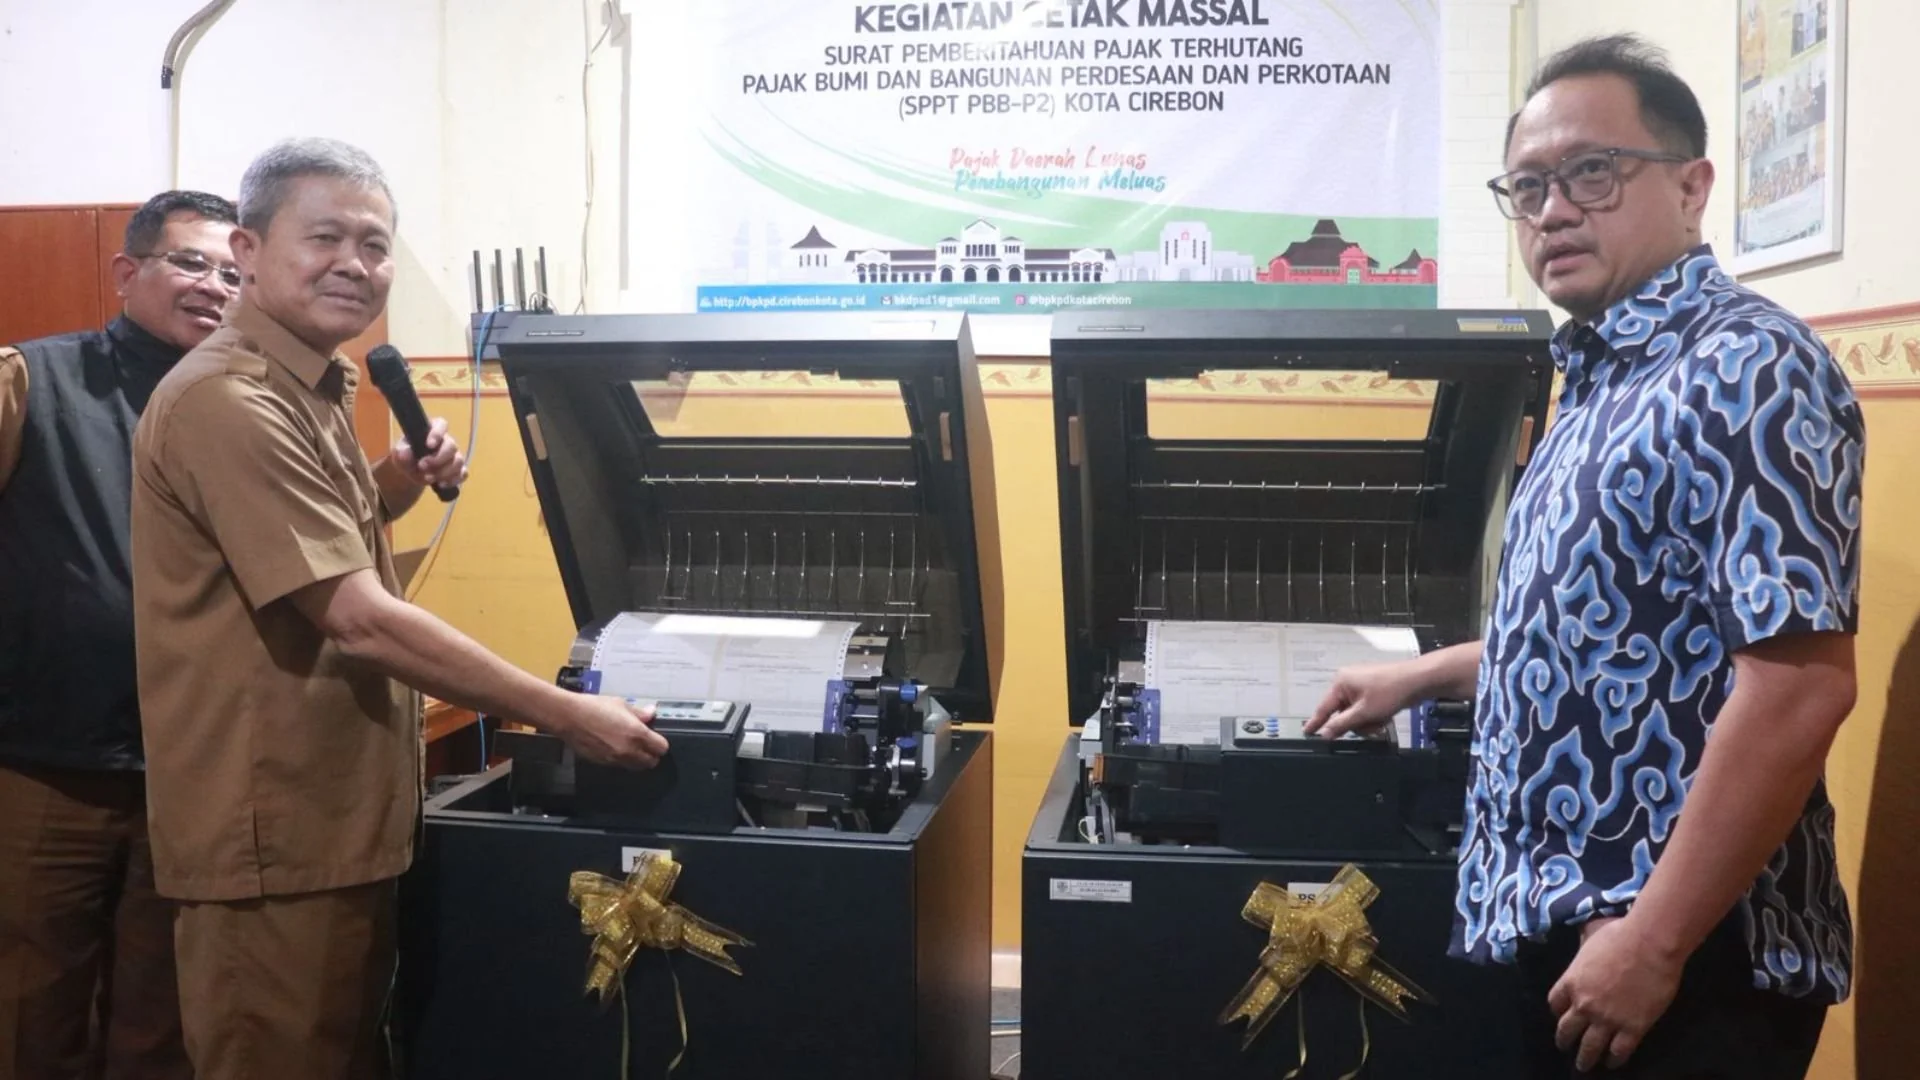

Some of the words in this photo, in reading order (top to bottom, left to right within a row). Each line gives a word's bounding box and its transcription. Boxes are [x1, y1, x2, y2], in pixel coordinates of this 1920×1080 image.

[855, 2, 1012, 33] KEGIATAN
[1138, 0, 1269, 27] MASSAL
[824, 44, 893, 66] SURAT
[902, 40, 1085, 63] PEMBERITAHUAN
[1094, 39, 1162, 59] PAJAK
[1171, 37, 1303, 58] TERHUTANG
[743, 73, 807, 94] PAJAK
[815, 71, 868, 91] BUMI
[877, 70, 921, 89] DAN
[930, 67, 1051, 88] BANGUNAN
[1061, 65, 1193, 86] PERDESAAN
[1203, 64, 1248, 84] DAN
[1258, 64, 1390, 84] PERKOTAAN
[899, 94, 959, 122] (SPPT
[968, 92, 1055, 118] PBB-P2)
[1065, 92, 1120, 112] KOTA
[1128, 91, 1224, 111] CIREBON
[950, 147, 1001, 174] Pajak
[1010, 147, 1076, 170] Daerah
[1085, 145, 1148, 170] Lunas
[954, 168, 1090, 199] Pembangunan
[1100, 167, 1167, 193] Meluas
